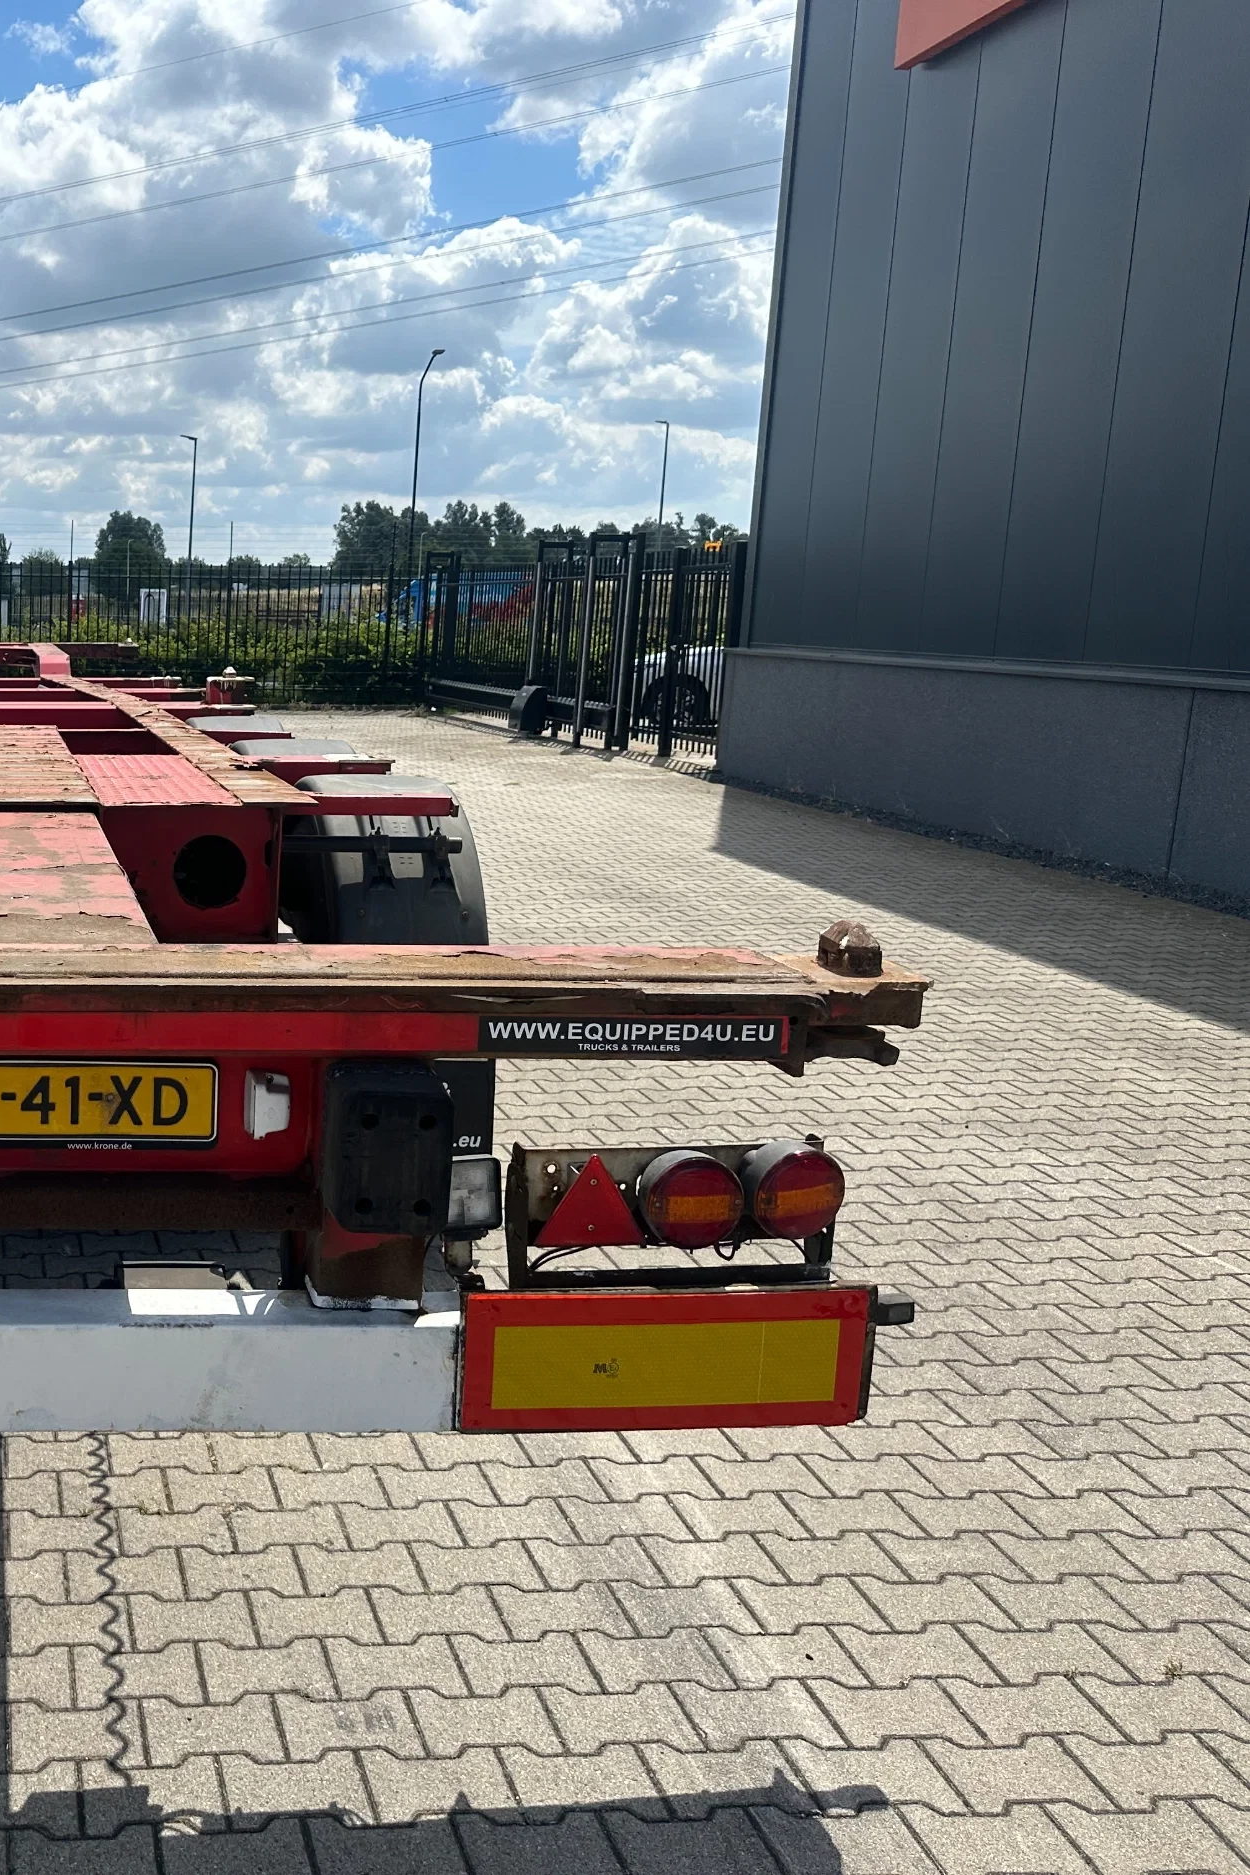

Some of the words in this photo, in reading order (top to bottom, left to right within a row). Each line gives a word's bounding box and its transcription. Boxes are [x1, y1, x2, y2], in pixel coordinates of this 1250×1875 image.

[488, 1021, 775, 1042] WWW.EQUIPPED4U.EU
[578, 1043, 619, 1051] TRUCKS
[621, 1043, 628, 1051] &
[631, 1043, 681, 1052] TRAILERS
[67, 1141, 133, 1150] www.krone.de
